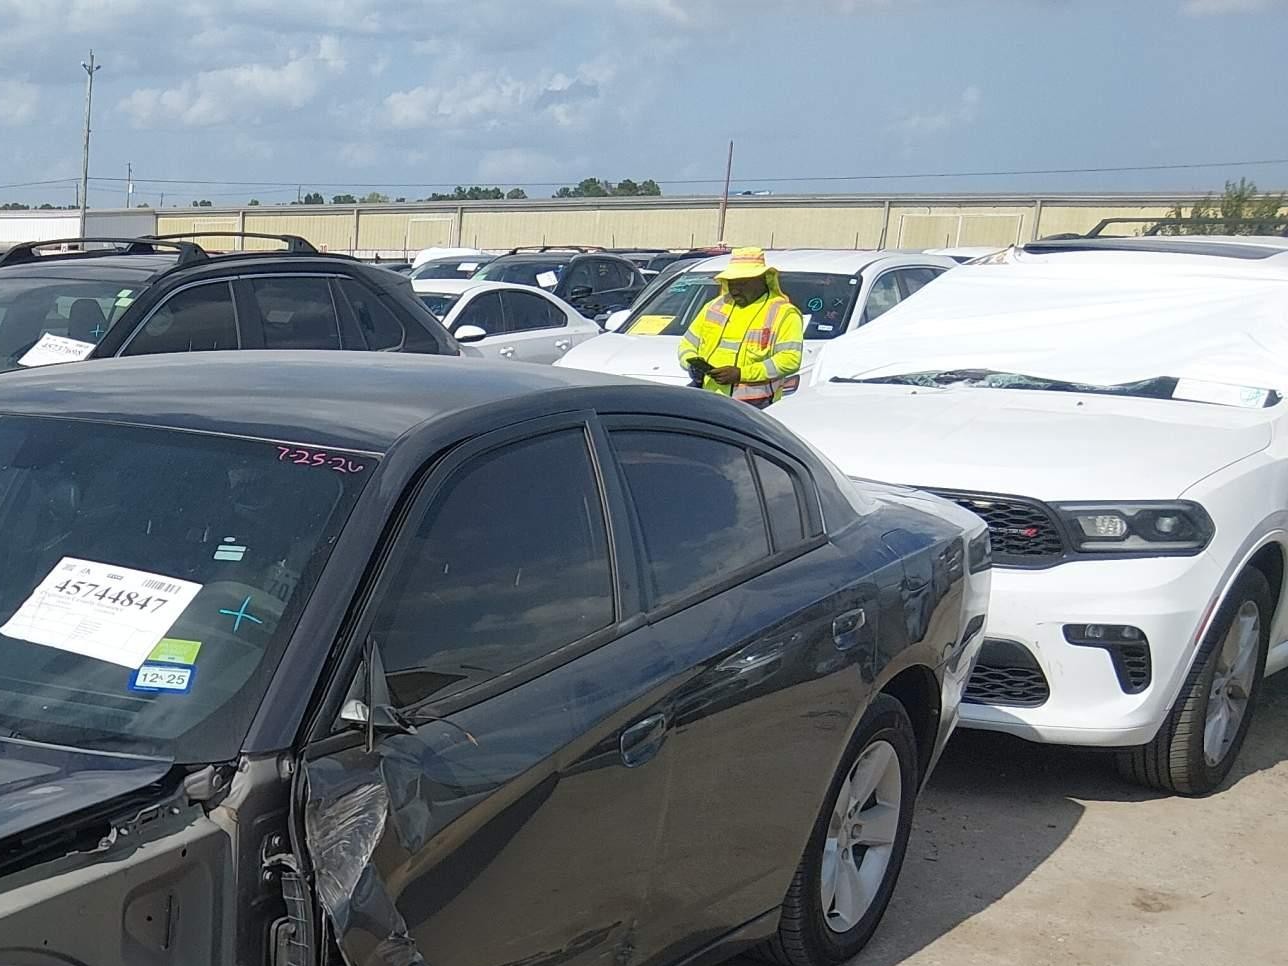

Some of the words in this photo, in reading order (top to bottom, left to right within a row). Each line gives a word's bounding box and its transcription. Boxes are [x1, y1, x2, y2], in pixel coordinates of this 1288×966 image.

[55, 578, 169, 613] 45744847
[142, 672, 158, 683] 12
[166, 673, 186, 685] 25
